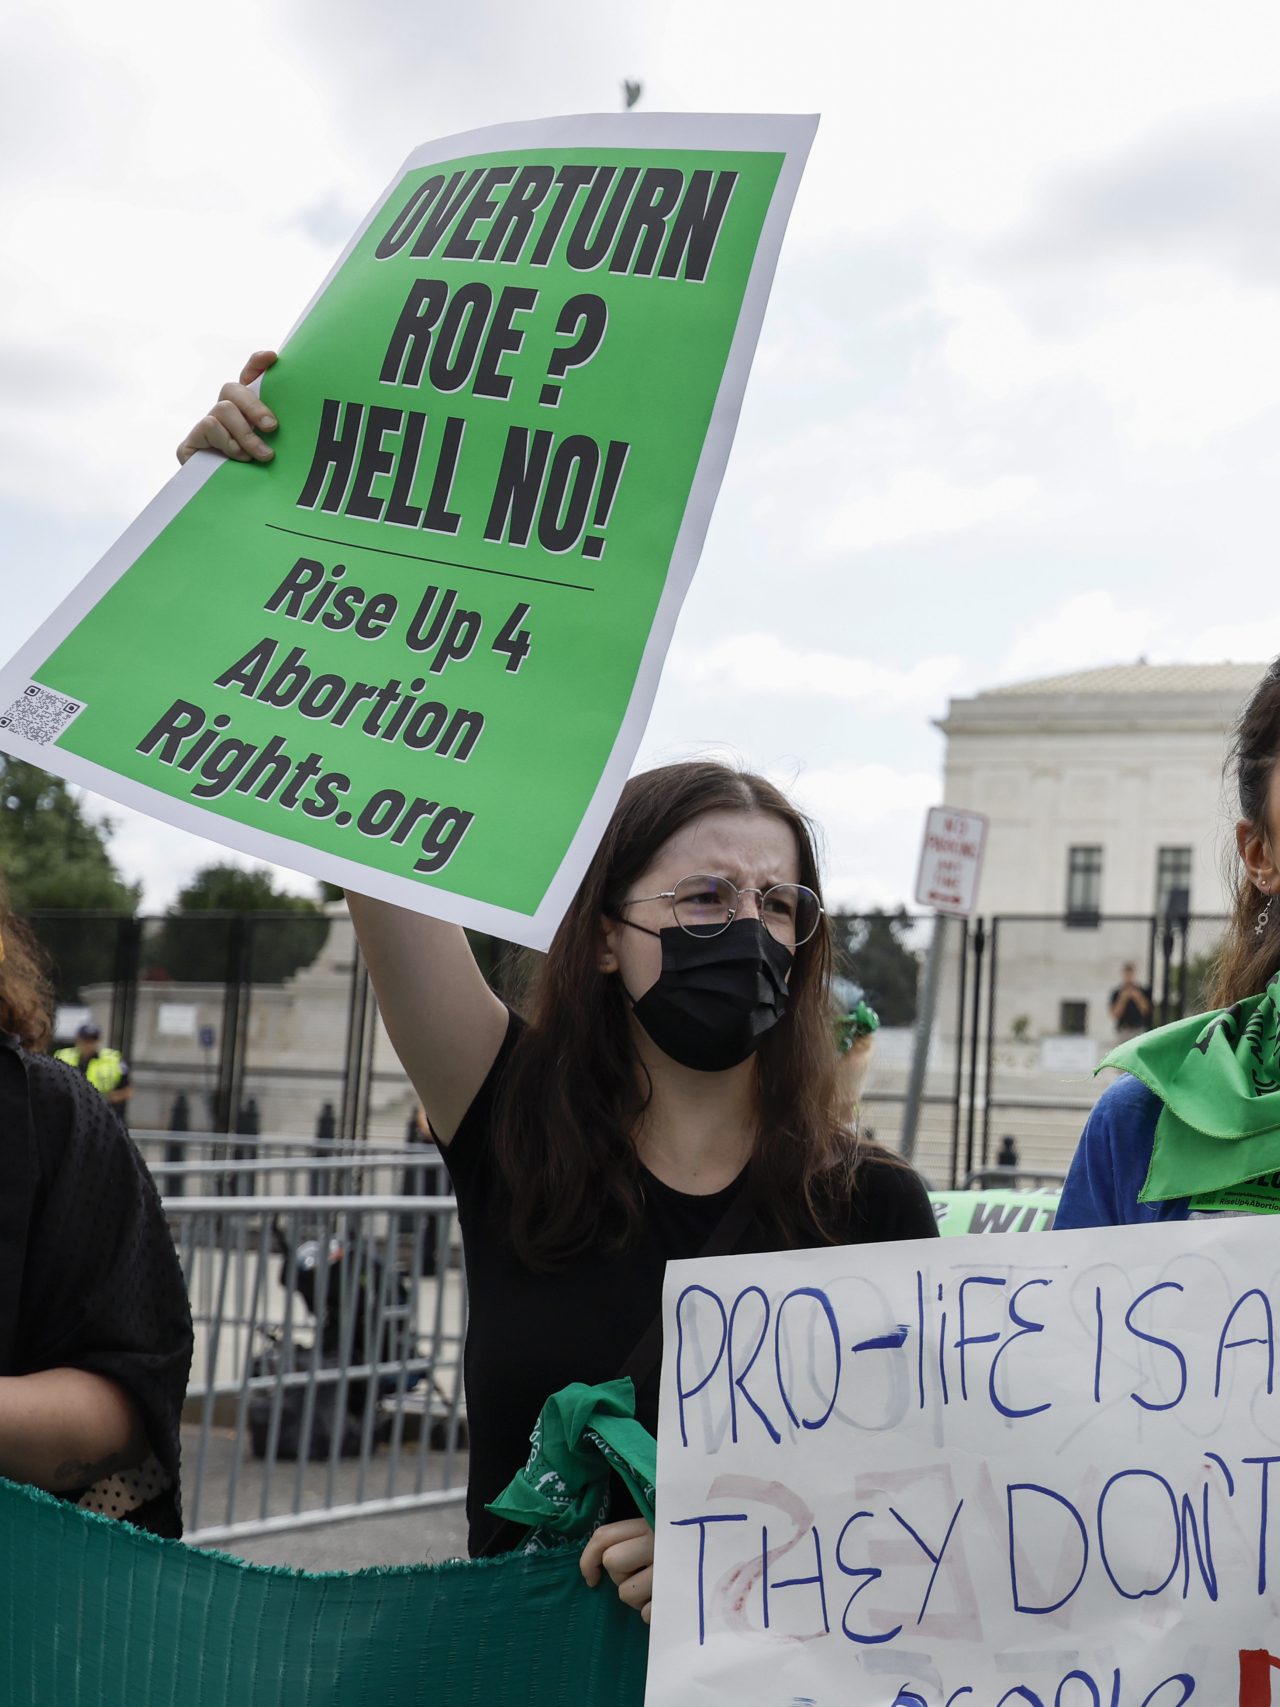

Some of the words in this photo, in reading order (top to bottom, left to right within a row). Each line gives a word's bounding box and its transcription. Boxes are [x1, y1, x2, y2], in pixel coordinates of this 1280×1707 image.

[374, 164, 740, 283] OVERTURN
[378, 278, 540, 400] ROE
[295, 398, 466, 535] HELL
[482, 425, 631, 559] NO!
[263, 557, 398, 638] Rise
[405, 585, 482, 674] Up
[490, 602, 532, 673] 4
[213, 637, 484, 762] Abortion
[135, 698, 475, 873] Rights.org
[1094, 1281, 1188, 1412] IS
[1214, 1287, 1275, 1399] A
[670, 1498, 964, 1645] THEY
